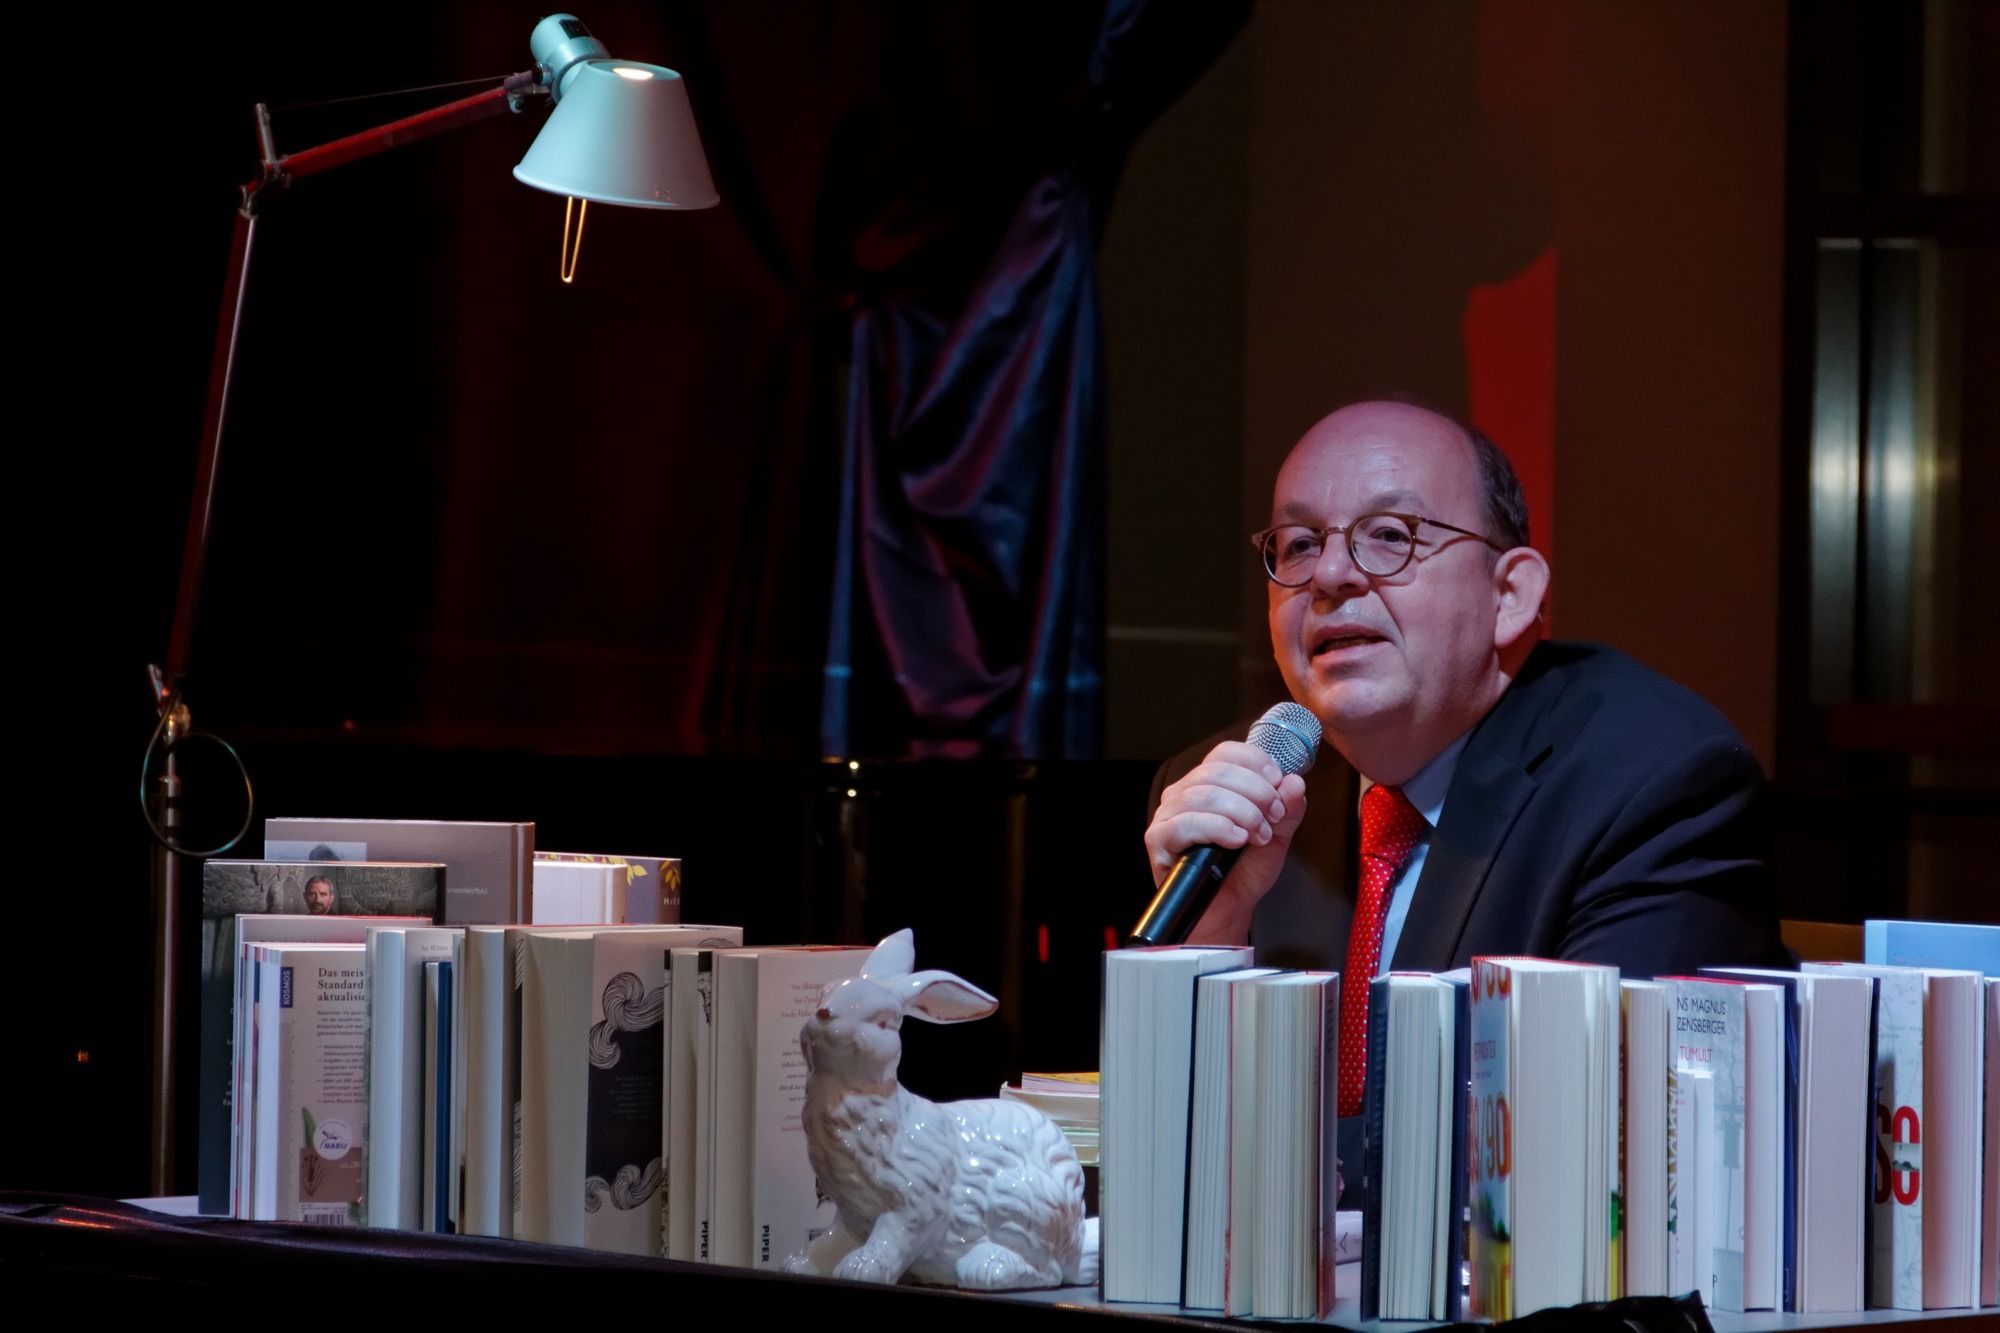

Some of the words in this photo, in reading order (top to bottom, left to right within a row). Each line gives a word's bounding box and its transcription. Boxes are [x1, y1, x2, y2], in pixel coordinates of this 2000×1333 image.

[318, 967, 338, 978] Das
[282, 969, 291, 1005] KOSMOS
[317, 979, 364, 990] Standard
[1691, 999, 1727, 1016] MAGNUS
[1679, 1045, 1713, 1063] TUMULT
[700, 1220, 709, 1259] PIPER
[761, 1224, 770, 1263] PIPER
